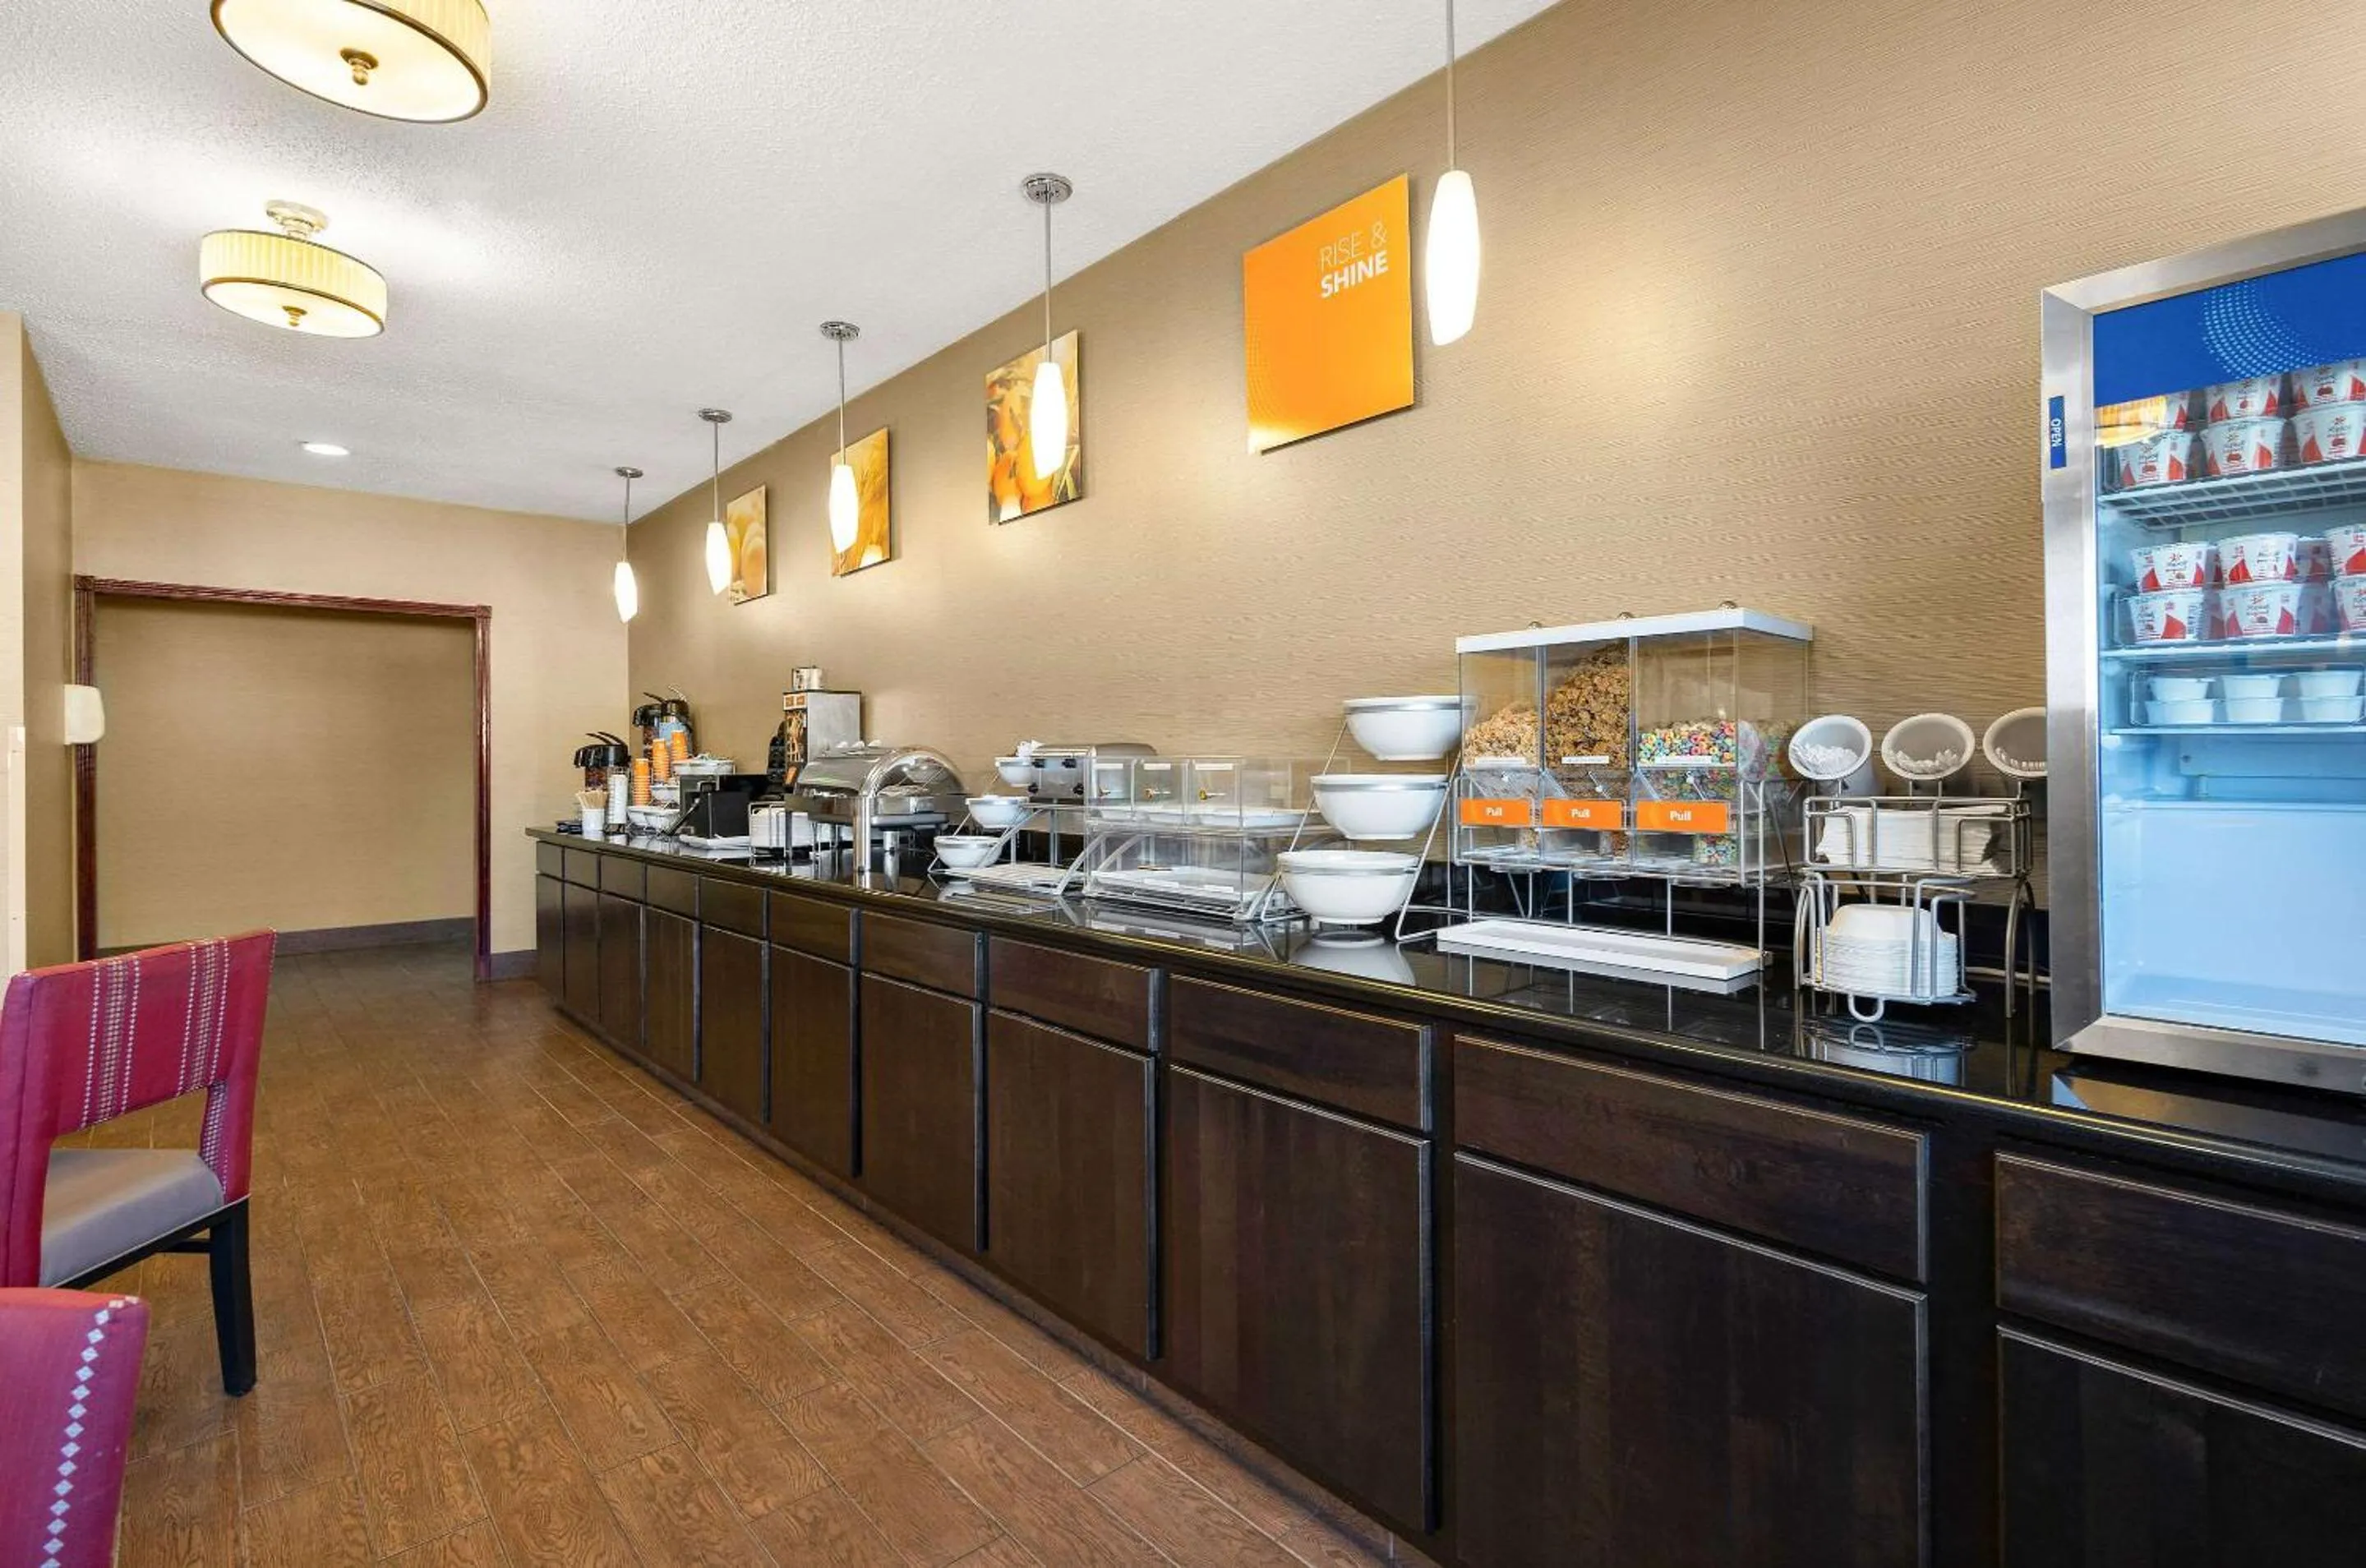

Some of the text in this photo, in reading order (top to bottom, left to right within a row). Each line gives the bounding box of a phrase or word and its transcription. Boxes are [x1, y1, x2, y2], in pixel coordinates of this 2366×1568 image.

[1320, 221, 1387, 273] RISE &
[1321, 250, 1389, 298] SHINE
[2050, 417, 2062, 448] OPEN
[1485, 807, 1503, 817] Pull
[1570, 808, 1591, 819] Pull
[1669, 810, 1692, 821] Pull
